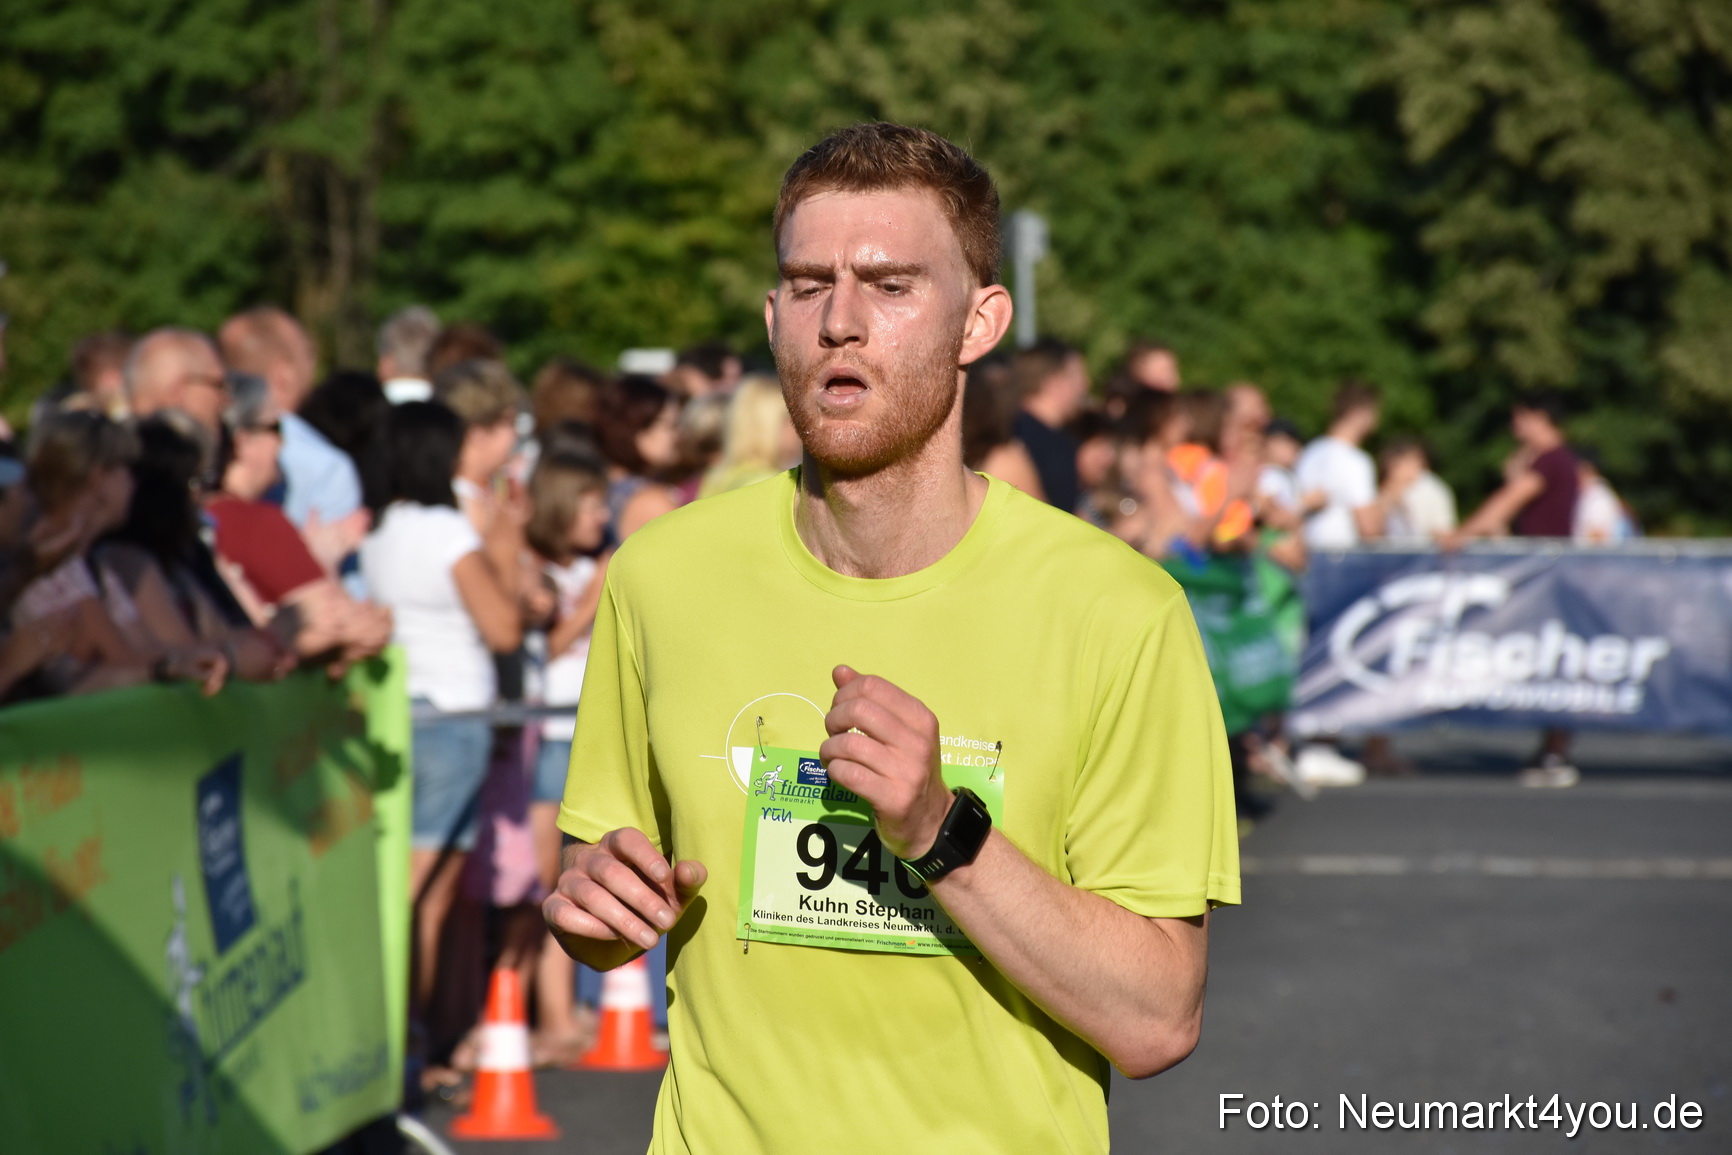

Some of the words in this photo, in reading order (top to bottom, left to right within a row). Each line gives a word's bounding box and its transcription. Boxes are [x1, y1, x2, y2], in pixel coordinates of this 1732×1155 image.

[1386, 617, 1672, 684] Fischer
[940, 735, 1002, 753] andkreise
[803, 763, 827, 774] Fischer
[780, 796, 815, 805] neumarkt
[799, 894, 848, 914] Kuhn
[855, 900, 935, 921] Stephan
[753, 909, 793, 922] Kliniken
[796, 914, 814, 924] des
[817, 916, 880, 930] Landkreises
[883, 921, 934, 933] Neumarkt
[945, 925, 955, 935] d.
